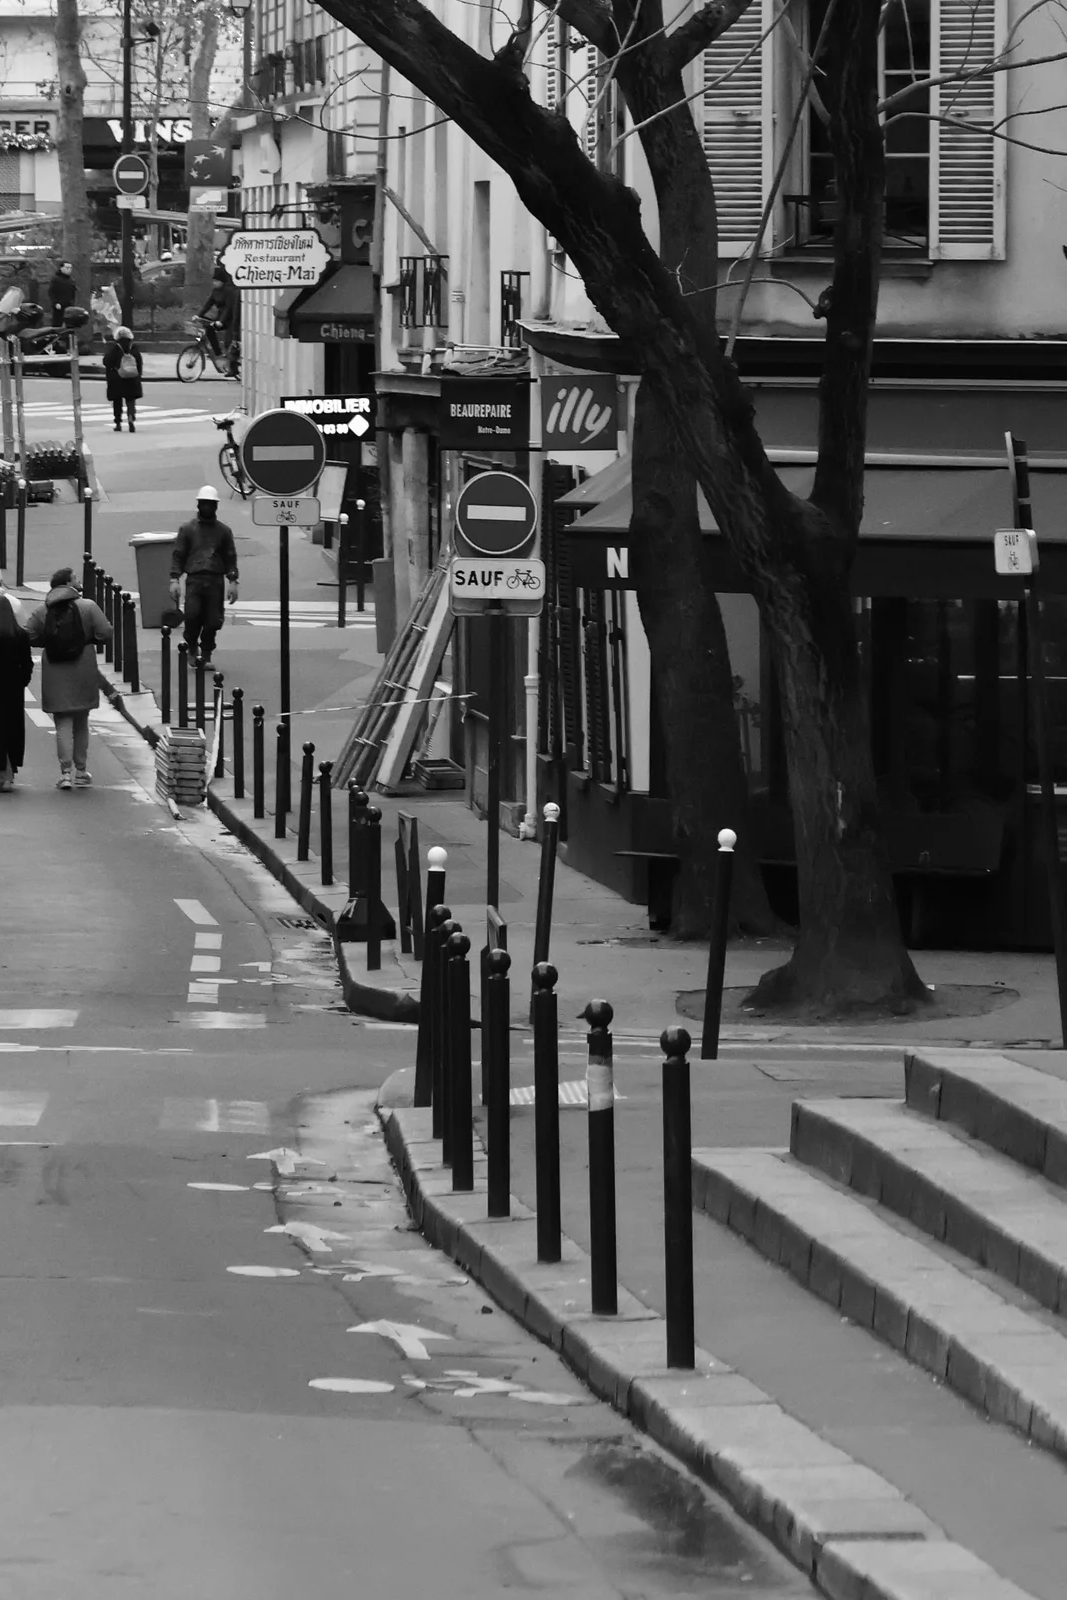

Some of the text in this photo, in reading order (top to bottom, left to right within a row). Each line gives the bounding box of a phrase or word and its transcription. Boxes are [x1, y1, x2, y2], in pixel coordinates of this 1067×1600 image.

[106, 119, 193, 143] VINS
[244, 253, 306, 263] Restaurant
[235, 265, 316, 284] Chieng-Mai
[450, 403, 512, 418] BEAUREPAIRE
[545, 386, 613, 445] illy
[272, 500, 300, 508] SAUF
[455, 570, 504, 587] SAUF
